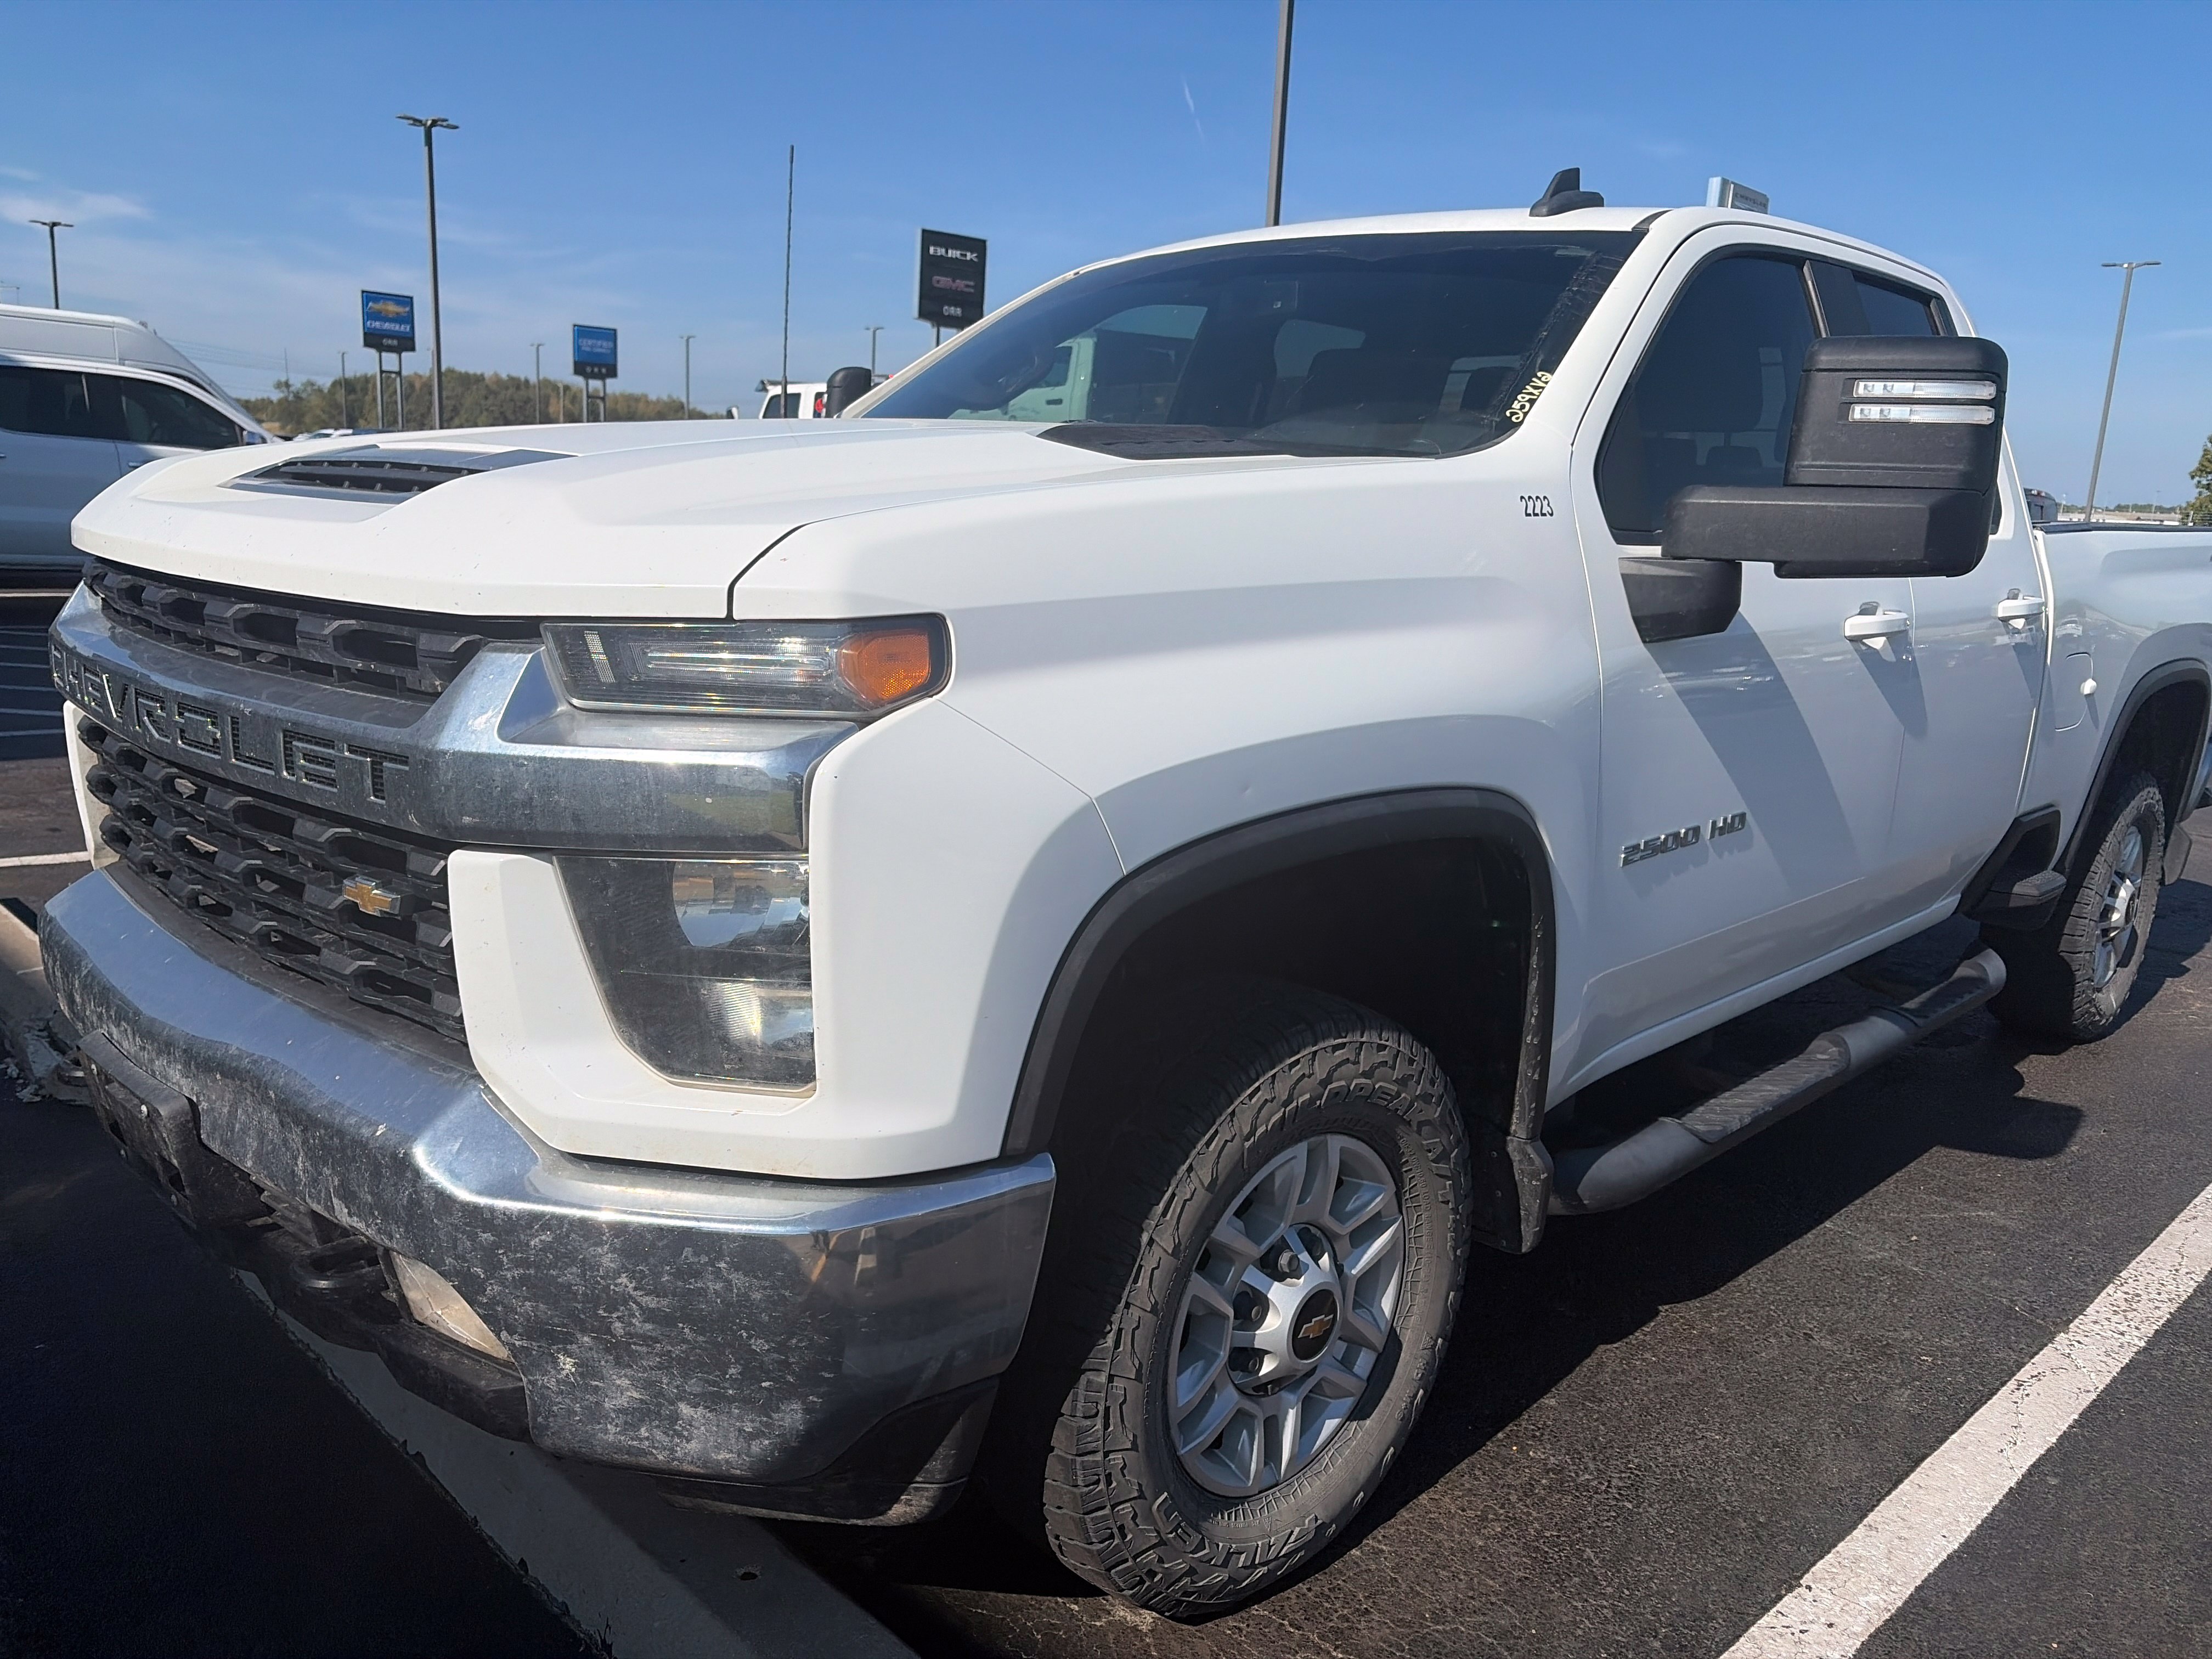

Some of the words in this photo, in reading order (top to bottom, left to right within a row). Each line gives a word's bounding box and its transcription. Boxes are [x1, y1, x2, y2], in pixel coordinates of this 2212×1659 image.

[929, 245, 978, 262] BUICK
[932, 276, 975, 293] GMC
[943, 306, 962, 317] ORR
[366, 320, 411, 332] CHEVROLET
[1520, 495, 1554, 517] 2223
[52, 644, 410, 804] CHEVROLET
[1620, 825, 1701, 868] 2500
[1707, 811, 1747, 840] HD
